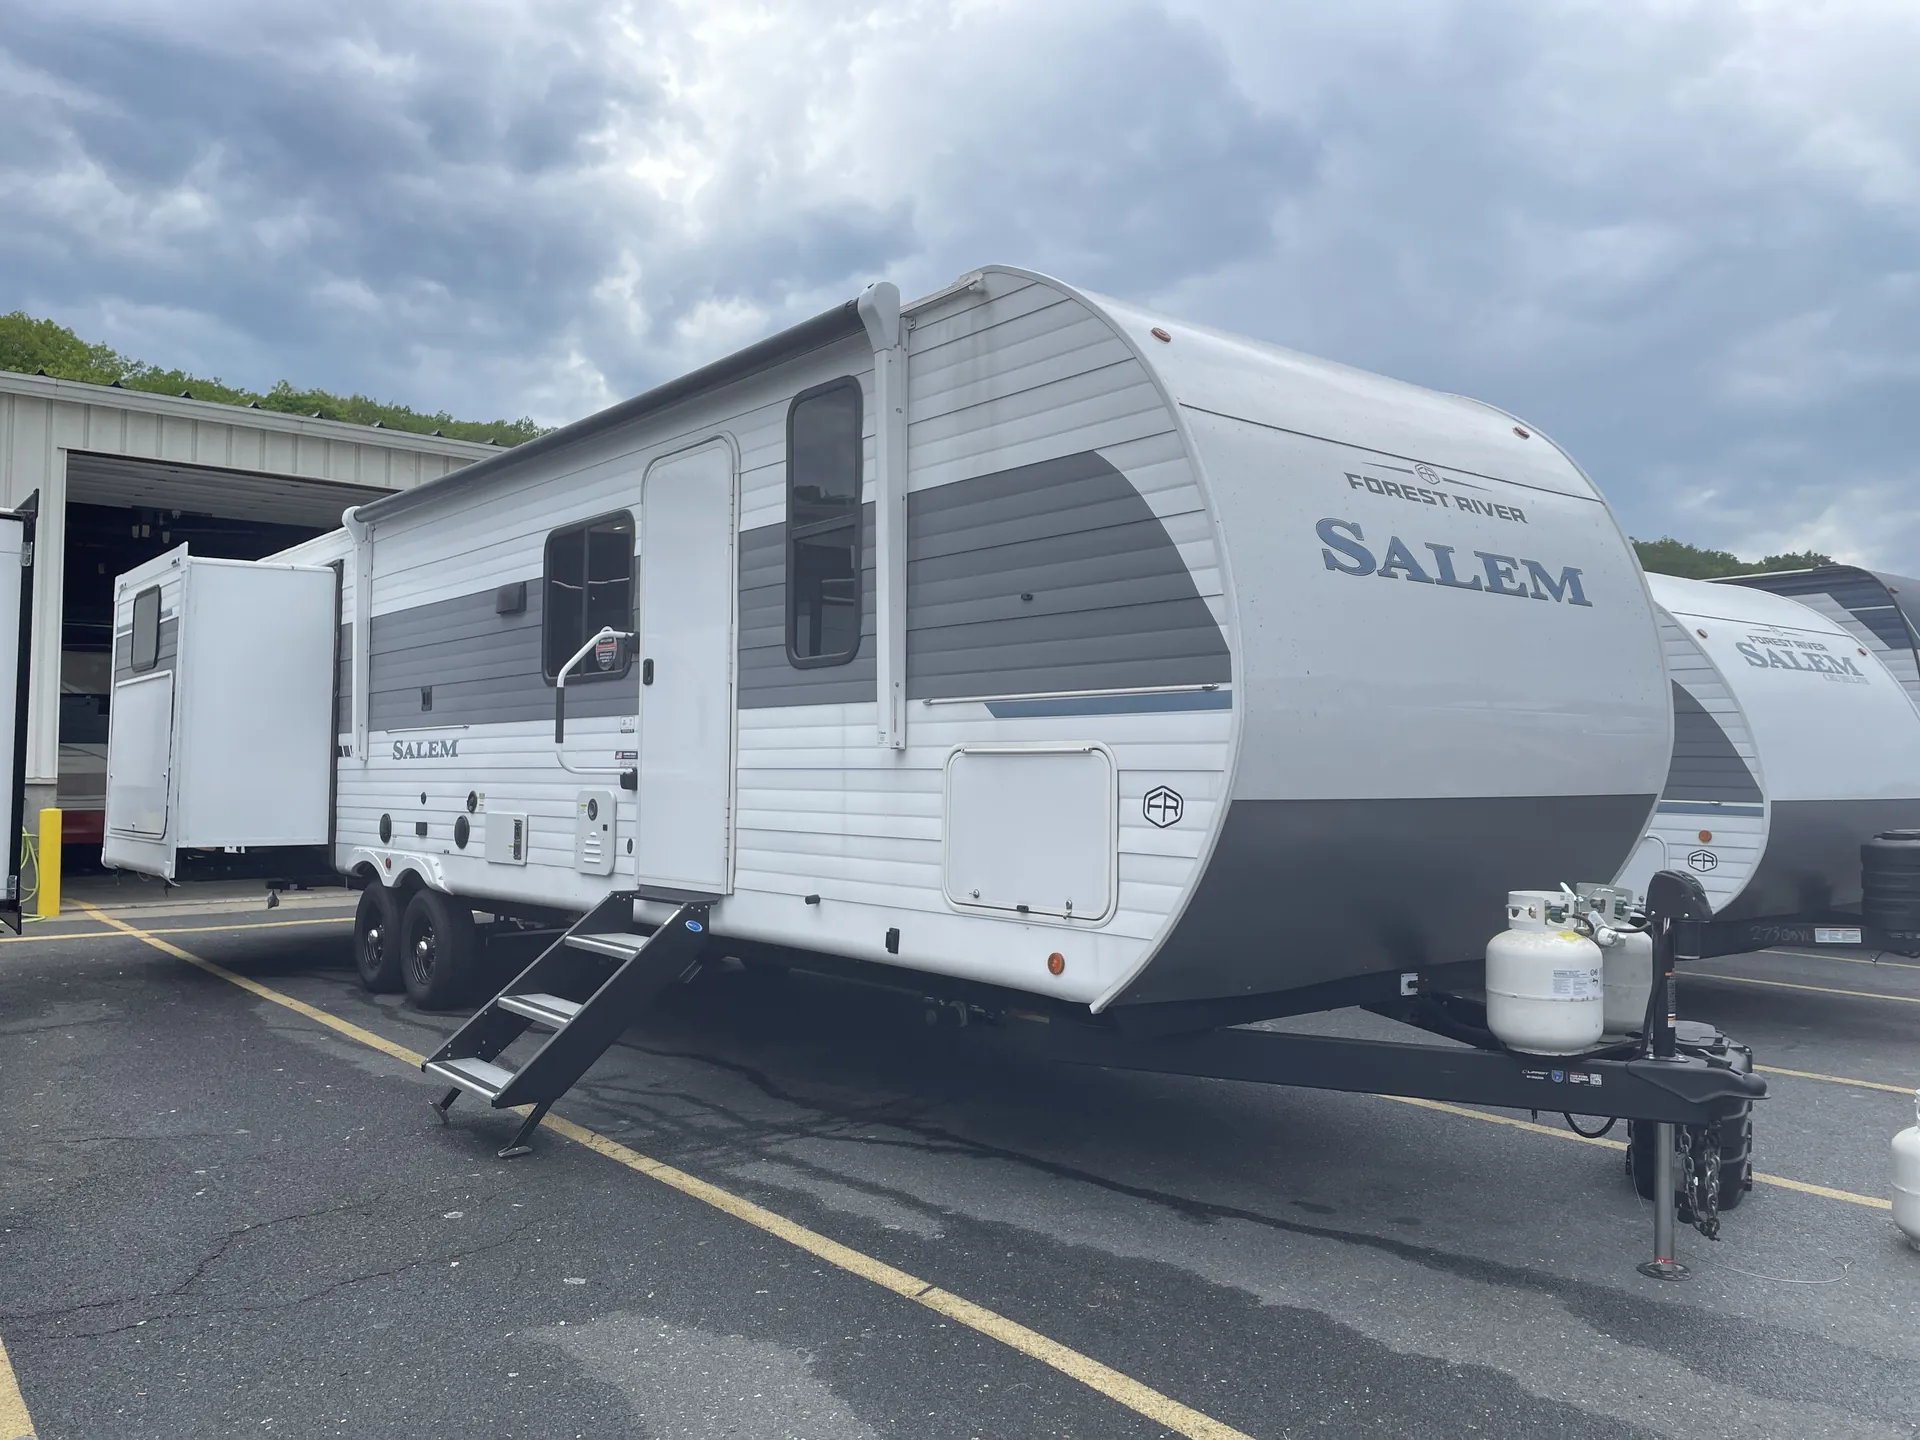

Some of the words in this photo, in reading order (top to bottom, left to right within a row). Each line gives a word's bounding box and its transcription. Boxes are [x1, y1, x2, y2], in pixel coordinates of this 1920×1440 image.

[1343, 472, 1449, 508] FOREST
[1452, 495, 1529, 524] RIVER
[1315, 517, 1593, 608] SALEM
[1735, 642, 1865, 676] SALEM
[1746, 635, 1795, 648] FOREST
[1793, 640, 1829, 652] RIVER
[392, 739, 460, 760] SALEM
